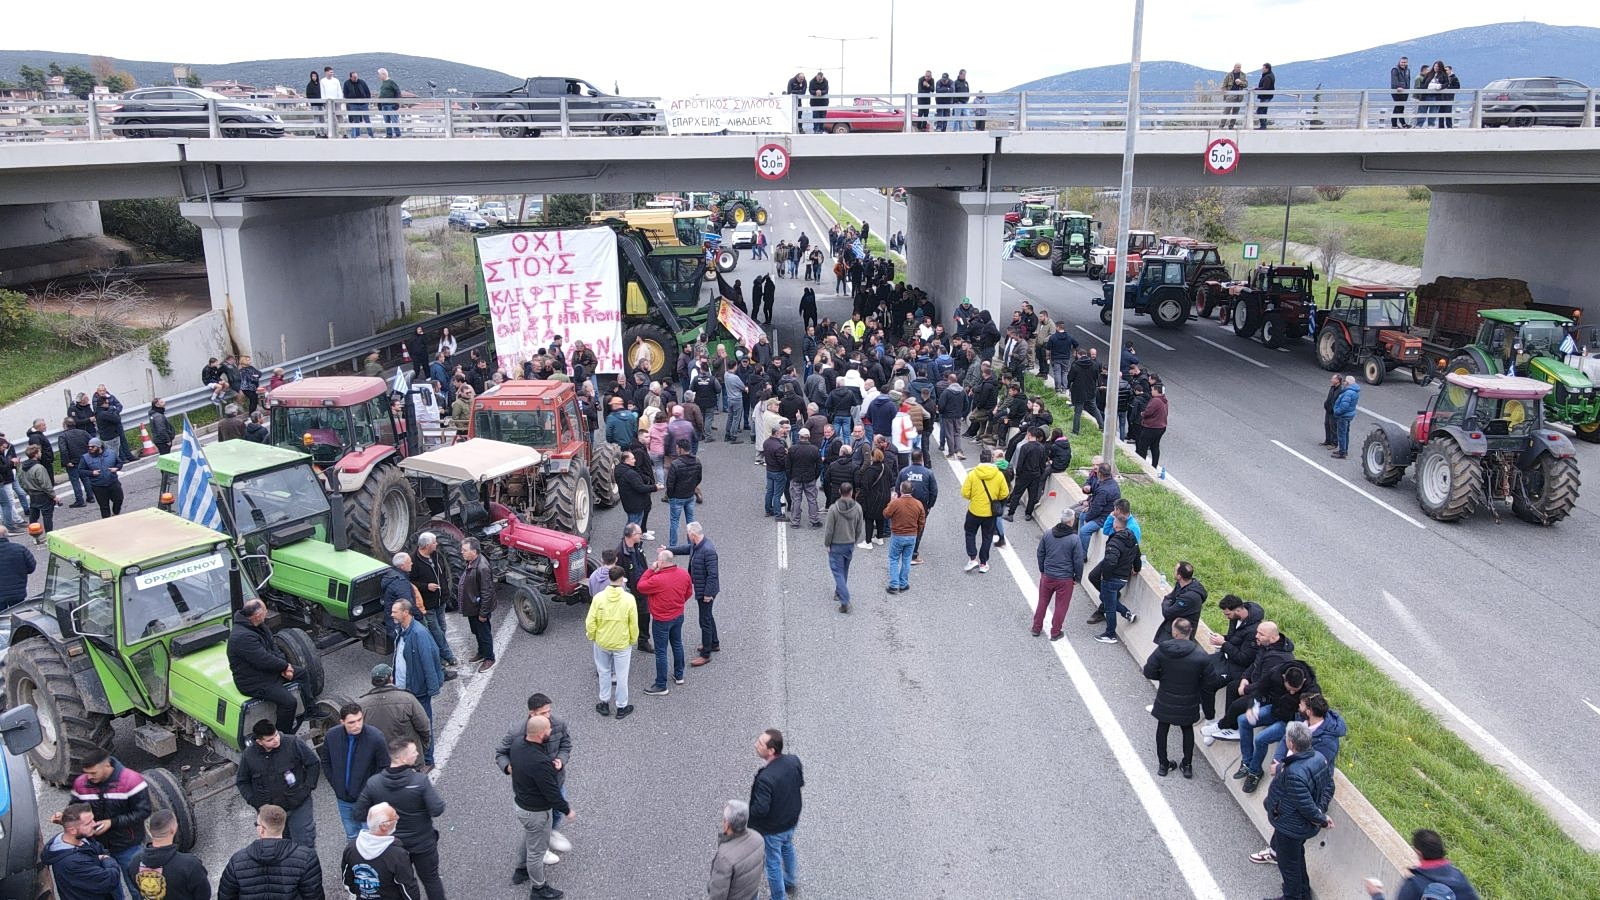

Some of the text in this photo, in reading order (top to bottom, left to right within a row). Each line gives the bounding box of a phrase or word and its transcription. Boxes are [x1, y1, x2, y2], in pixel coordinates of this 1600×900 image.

[671, 99, 782, 110] ΑΓΡΟΤΙΚΟΣ ΣΥΛΛΟΓΟΣ
[727, 116, 773, 127] ΛΙΒΑΔΕΙΑΣ
[511, 231, 562, 254] ΟΧΙ
[484, 253, 576, 283] ΣΤΟΥΣ
[491, 281, 602, 306] ΚΛΕΦΤΕΣ
[491, 299, 599, 322] ΨΕΥΤΕΣ
[144, 559, 217, 585] ΟΡΧΟΜΕΝΟΥ
